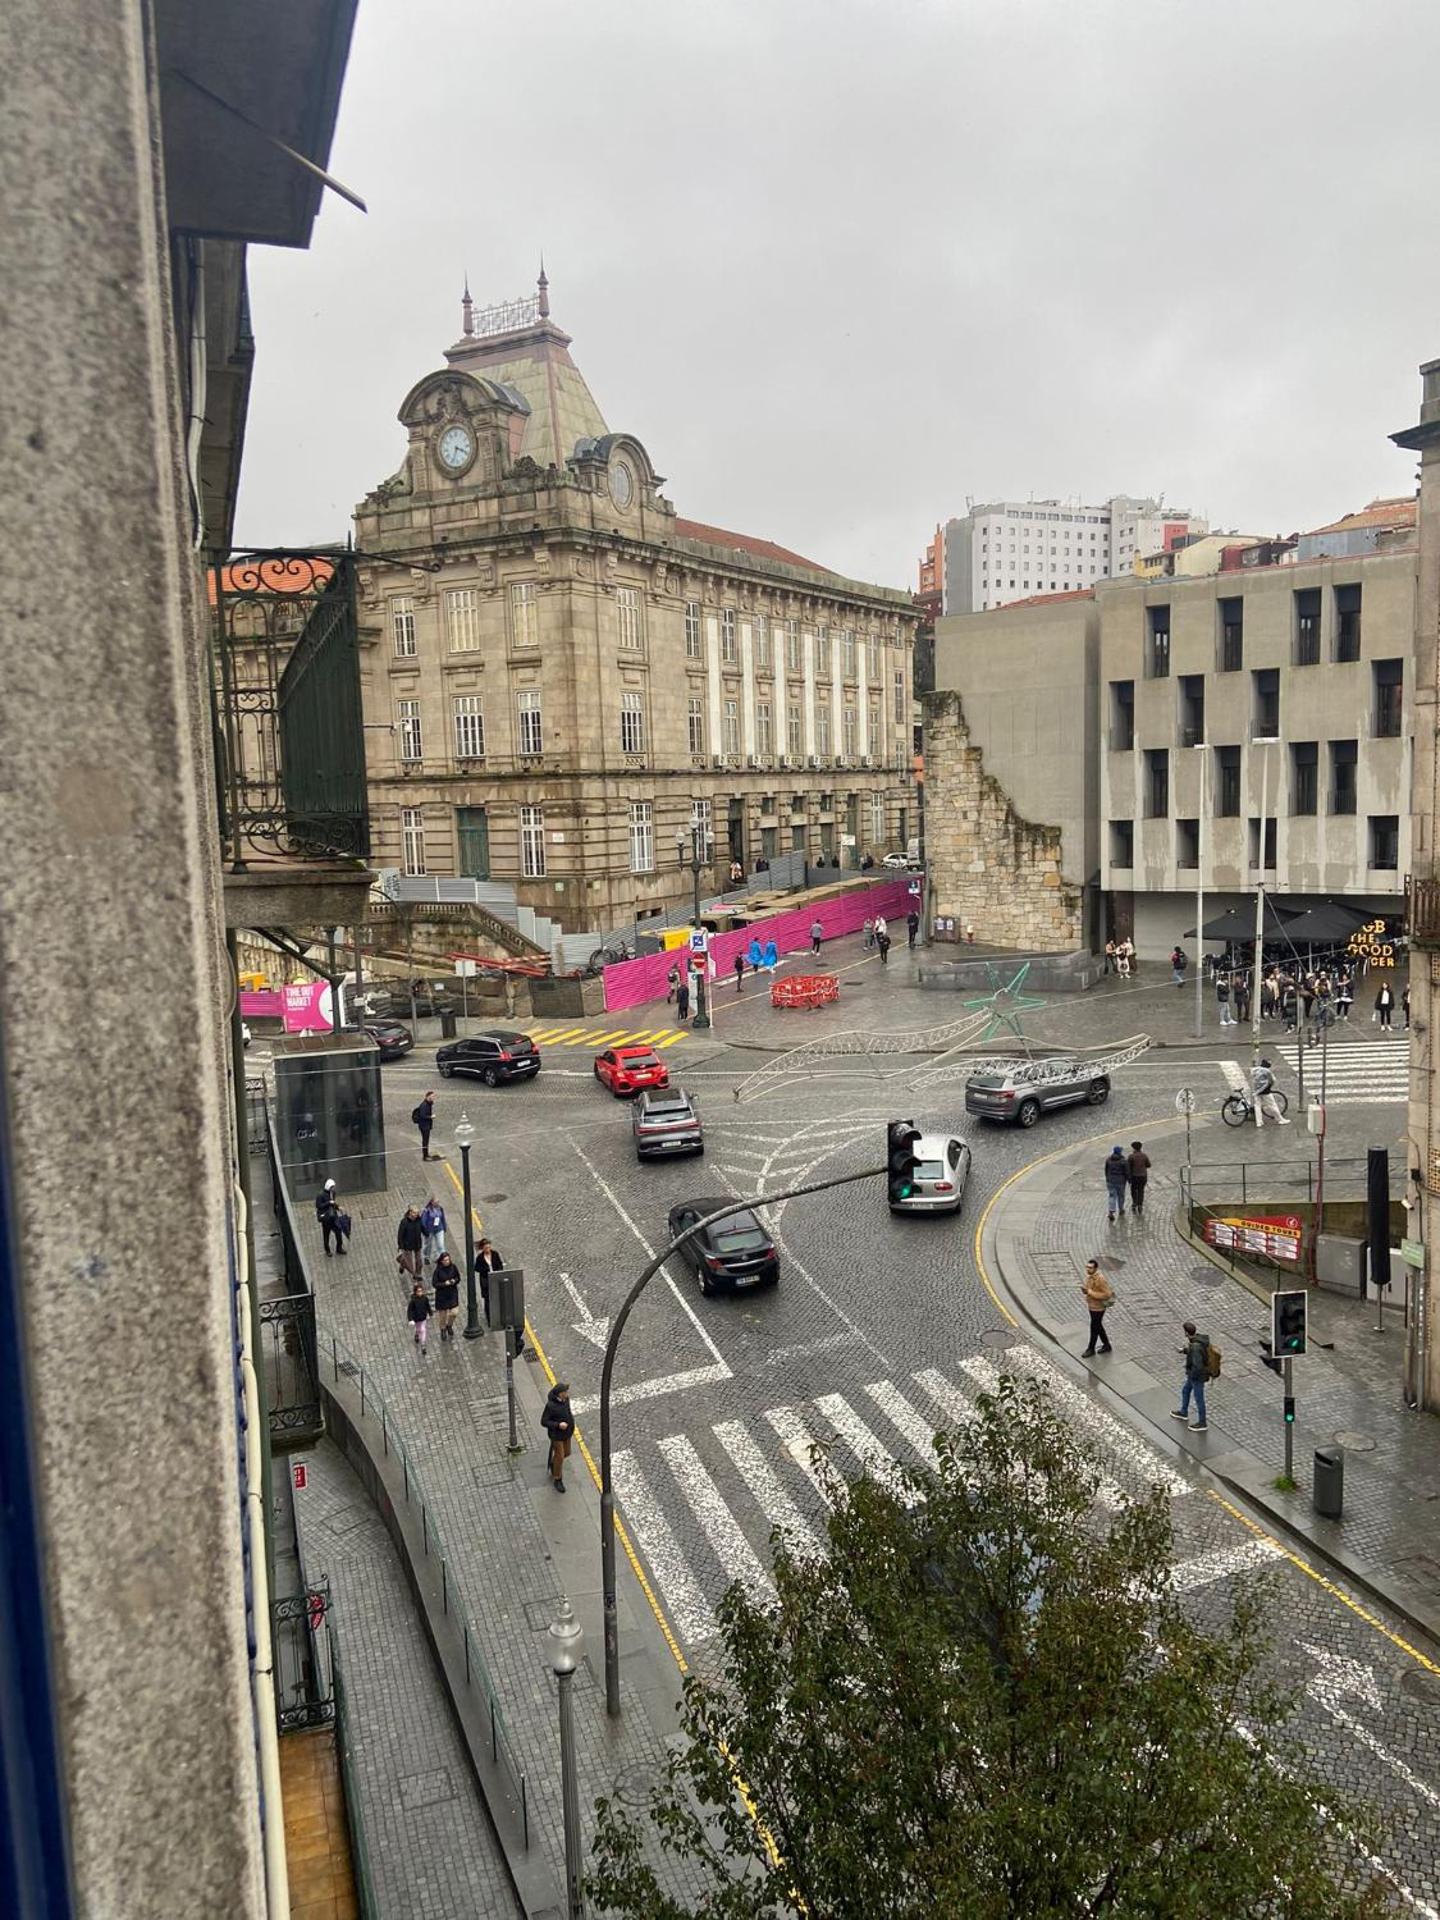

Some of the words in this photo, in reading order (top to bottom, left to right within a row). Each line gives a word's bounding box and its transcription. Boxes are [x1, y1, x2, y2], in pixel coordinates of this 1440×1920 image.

[1347, 944, 1393, 956] GOOD
[1240, 1220, 1271, 1231] GUIDED
[1272, 1226, 1298, 1236] TOURS
